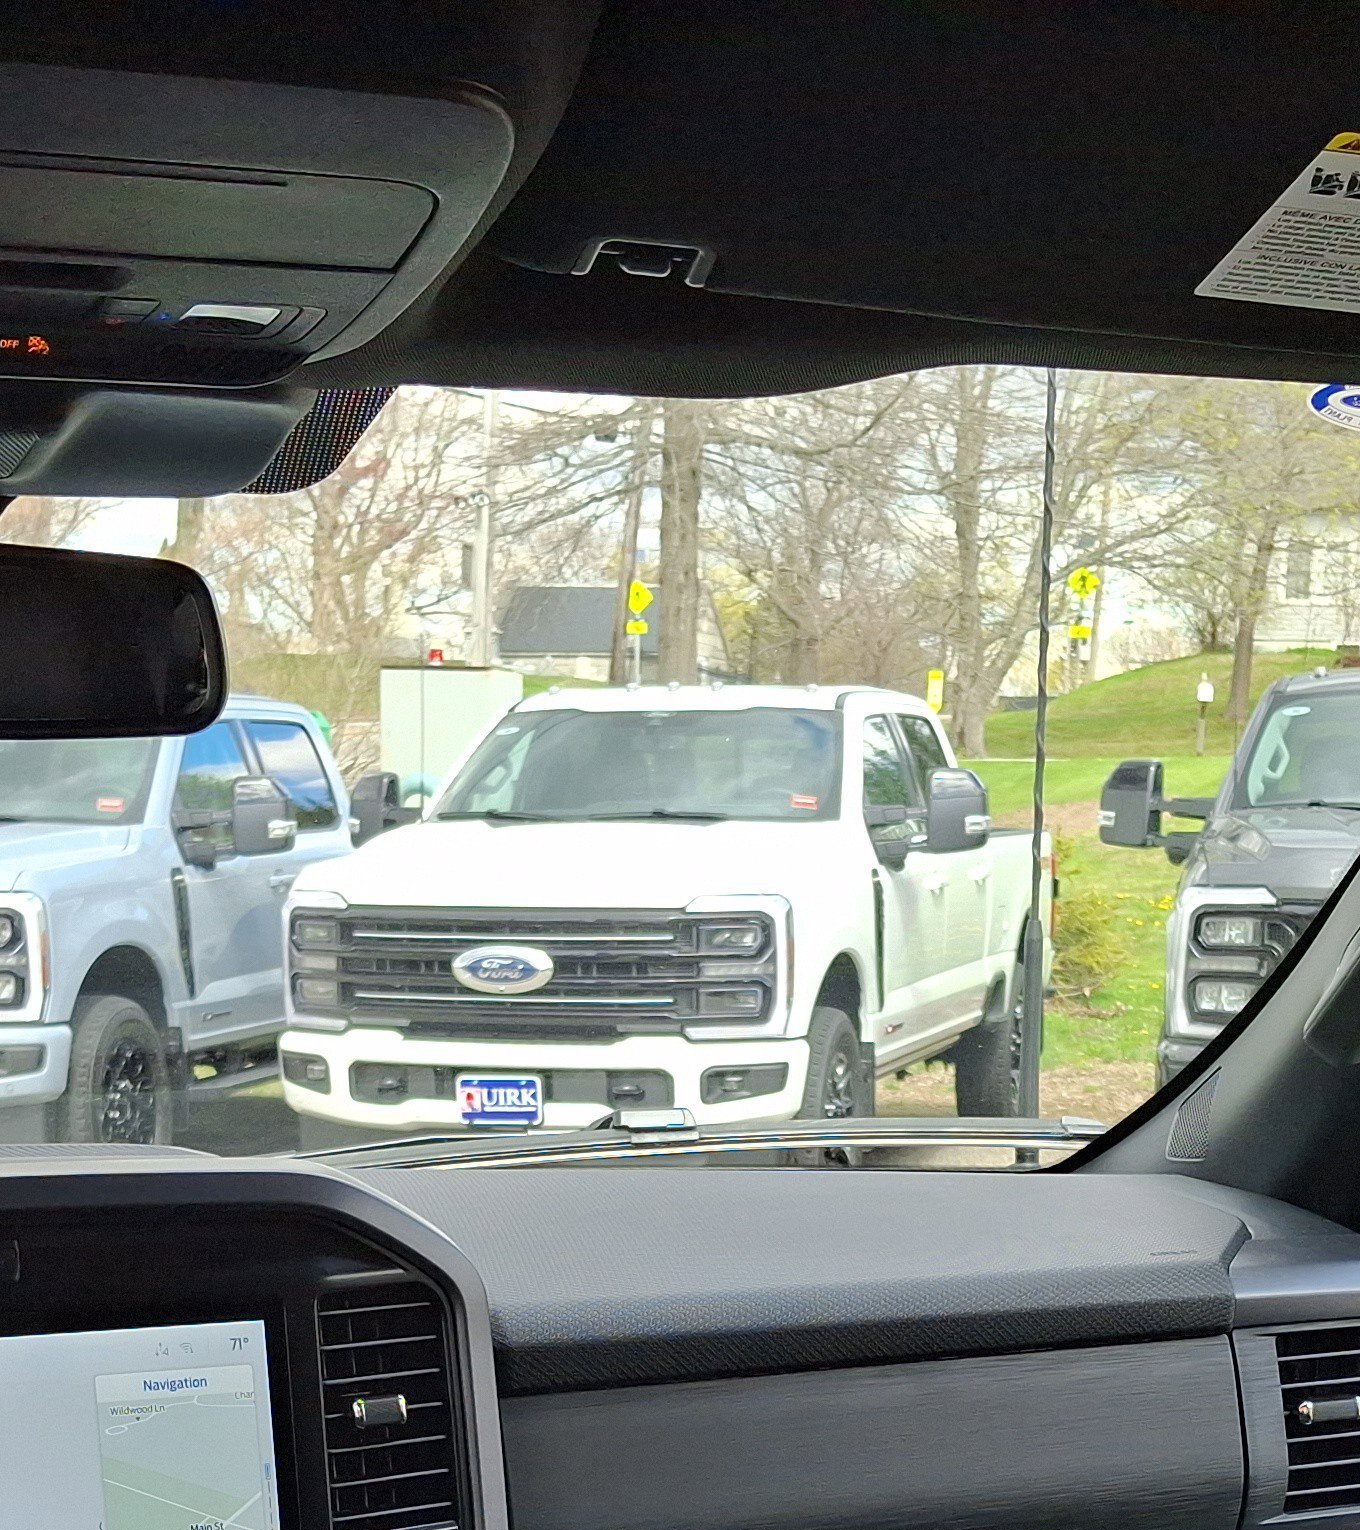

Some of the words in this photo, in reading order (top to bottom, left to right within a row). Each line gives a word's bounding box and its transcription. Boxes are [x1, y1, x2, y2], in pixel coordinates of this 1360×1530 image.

[0, 339, 19, 349] OFF
[477, 959, 524, 979] Ford
[144, 1377, 207, 1392] Navigation
[110, 1406, 153, 1416] Wildwood
[215, 1522, 224, 1530] St
